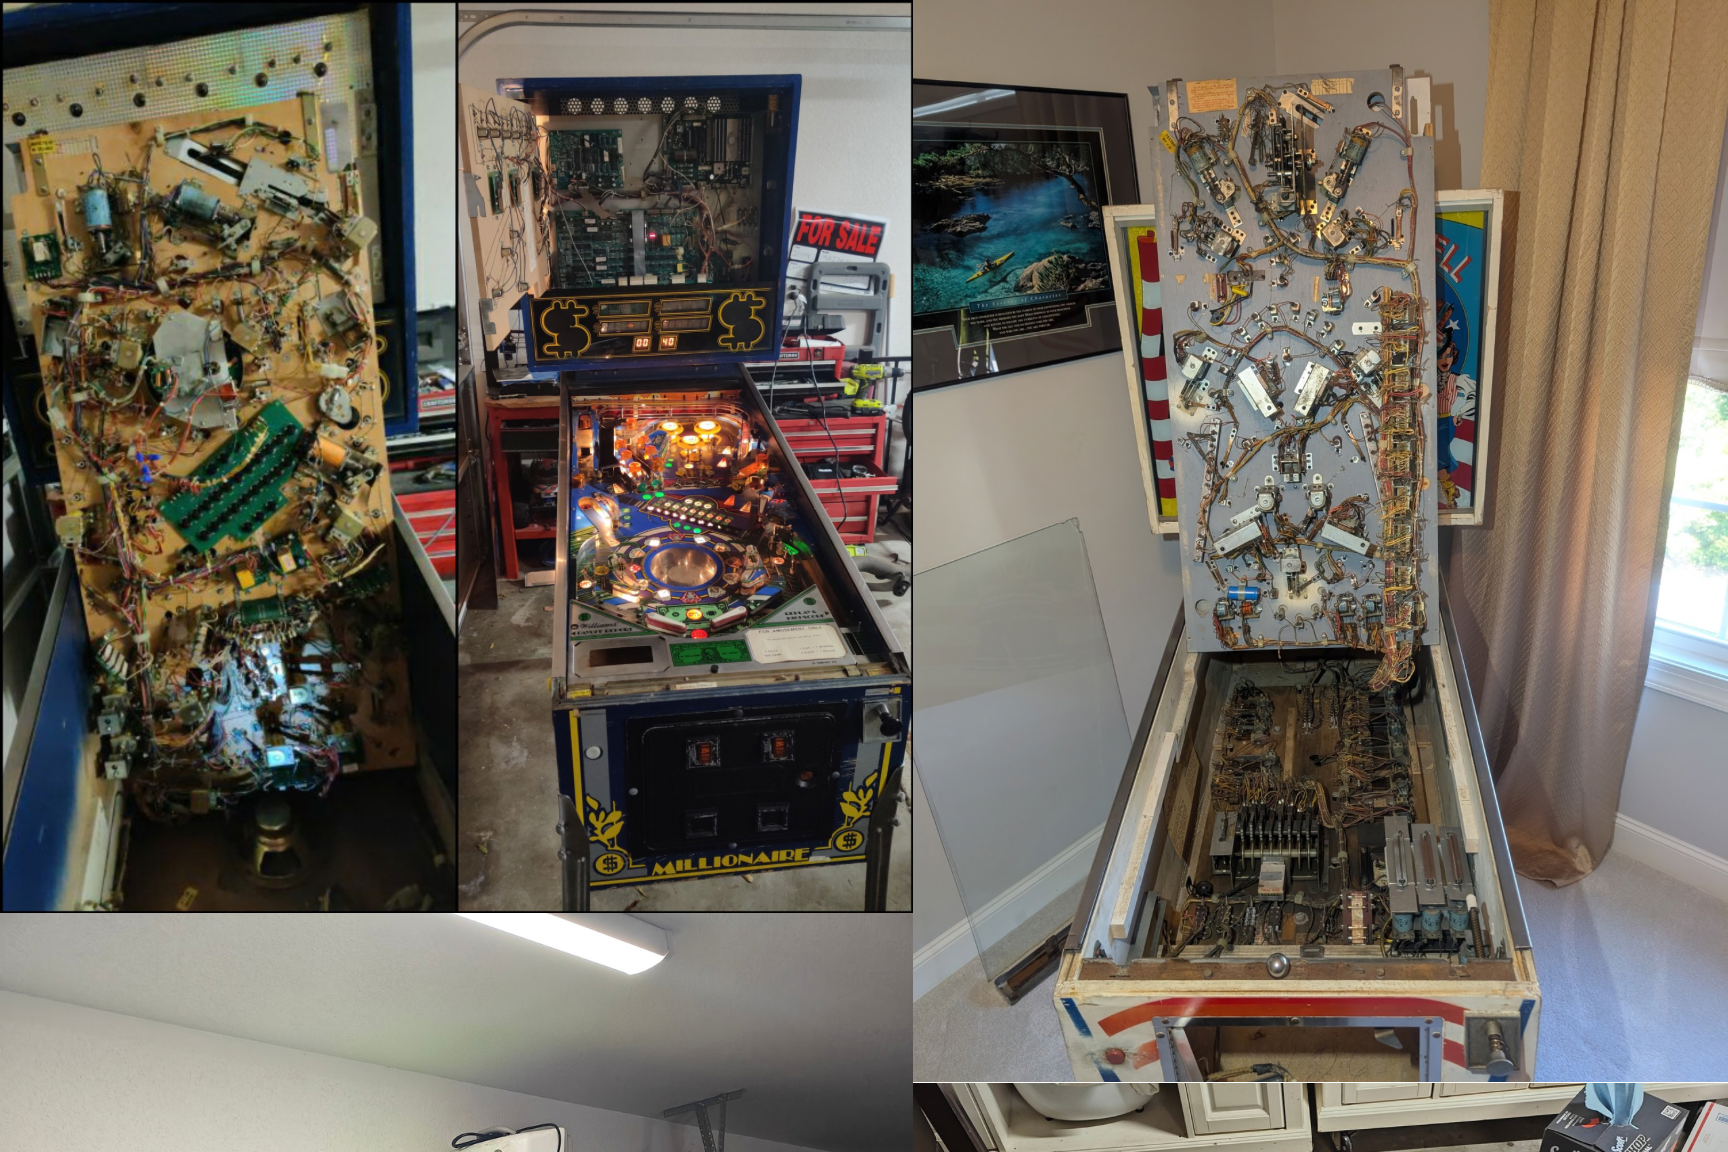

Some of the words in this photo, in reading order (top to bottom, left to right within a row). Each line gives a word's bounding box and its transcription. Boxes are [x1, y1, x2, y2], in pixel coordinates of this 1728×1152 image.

[797, 214, 835, 247] FOR
[835, 220, 882, 254] SALE
[1030, 293, 1062, 301] Character
[636, 338, 649, 348] 00
[662, 337, 675, 347] 40
[652, 848, 811, 877] MILLIONAIRE
